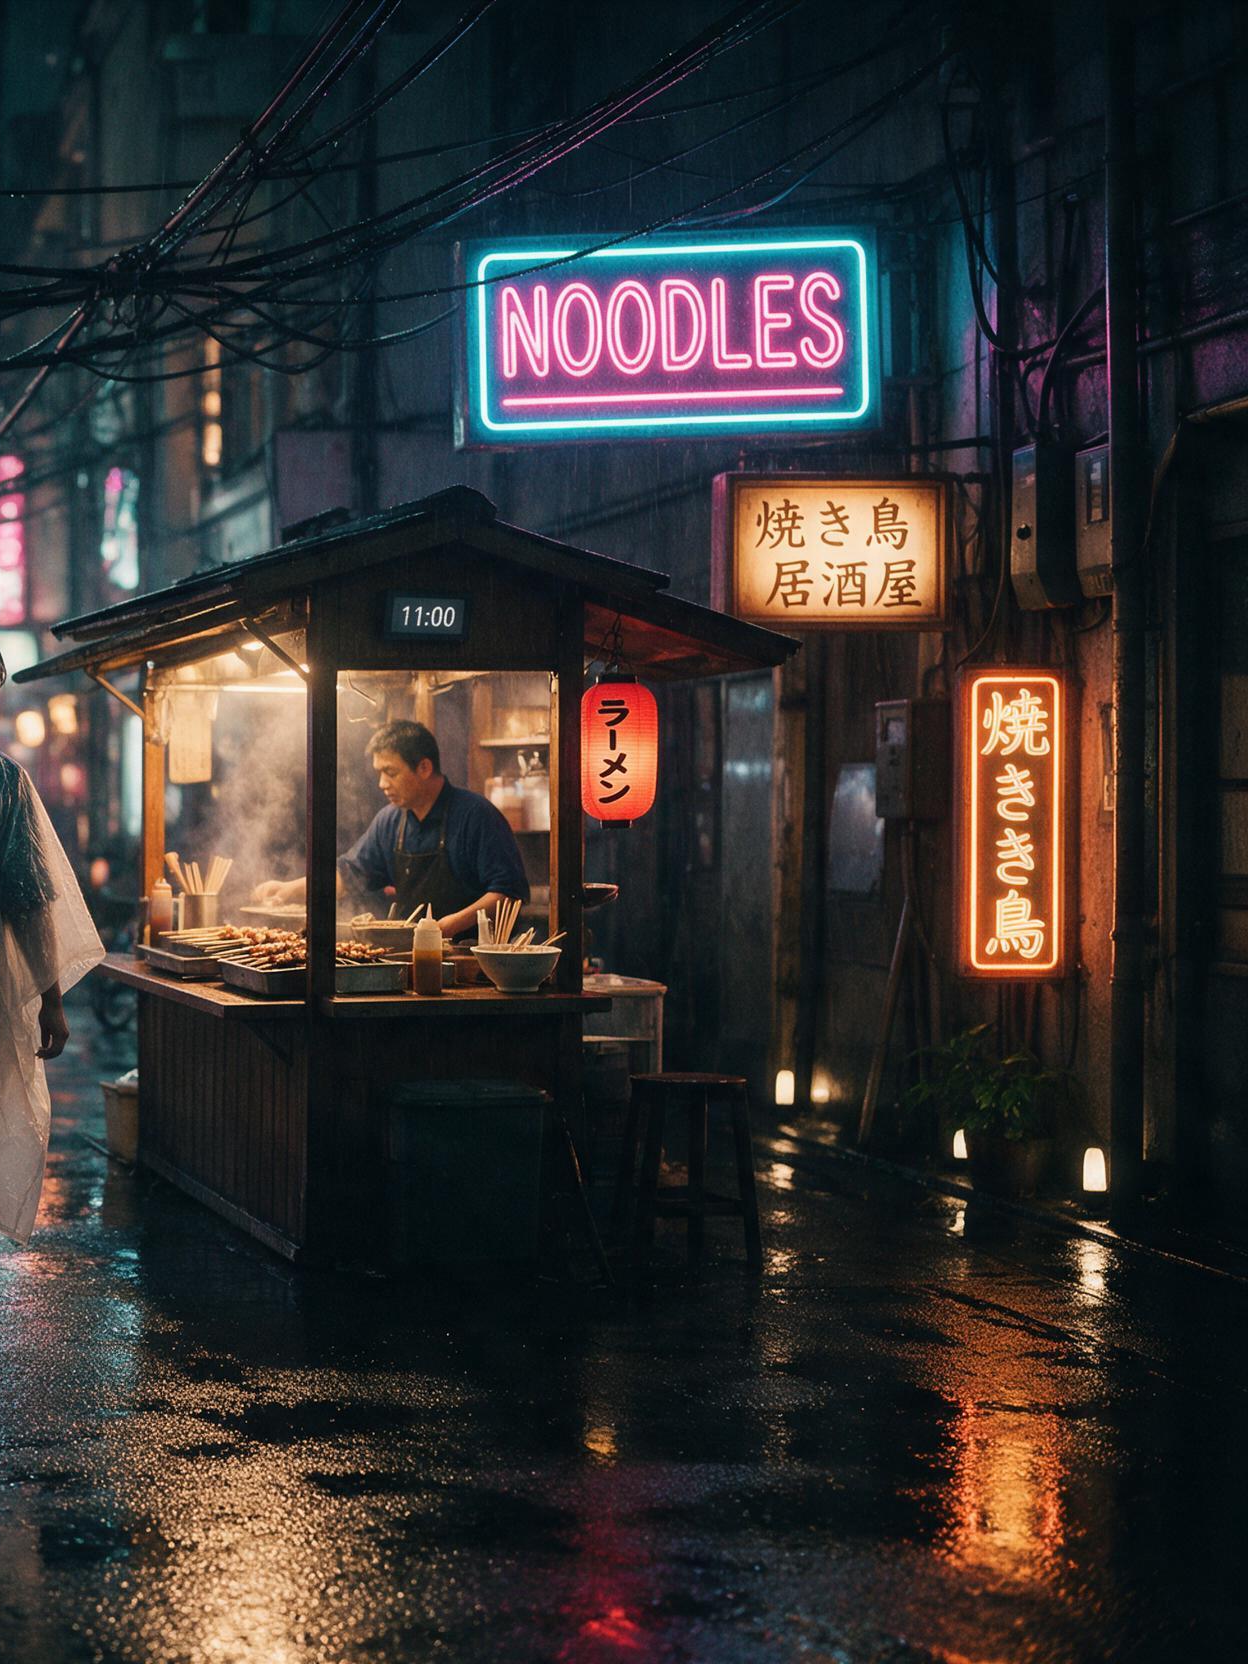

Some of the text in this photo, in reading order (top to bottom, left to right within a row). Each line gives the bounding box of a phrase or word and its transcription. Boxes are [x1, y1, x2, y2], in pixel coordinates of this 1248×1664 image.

[501, 271, 845, 379] NOODLES
[755, 497, 909, 550] 焼き鳥
[402, 605, 456, 628] 11:00
[765, 559, 922, 608] 居酒屋
[597, 699, 631, 804] ラーメン
[980, 688, 1051, 959] 焼きき鳥
